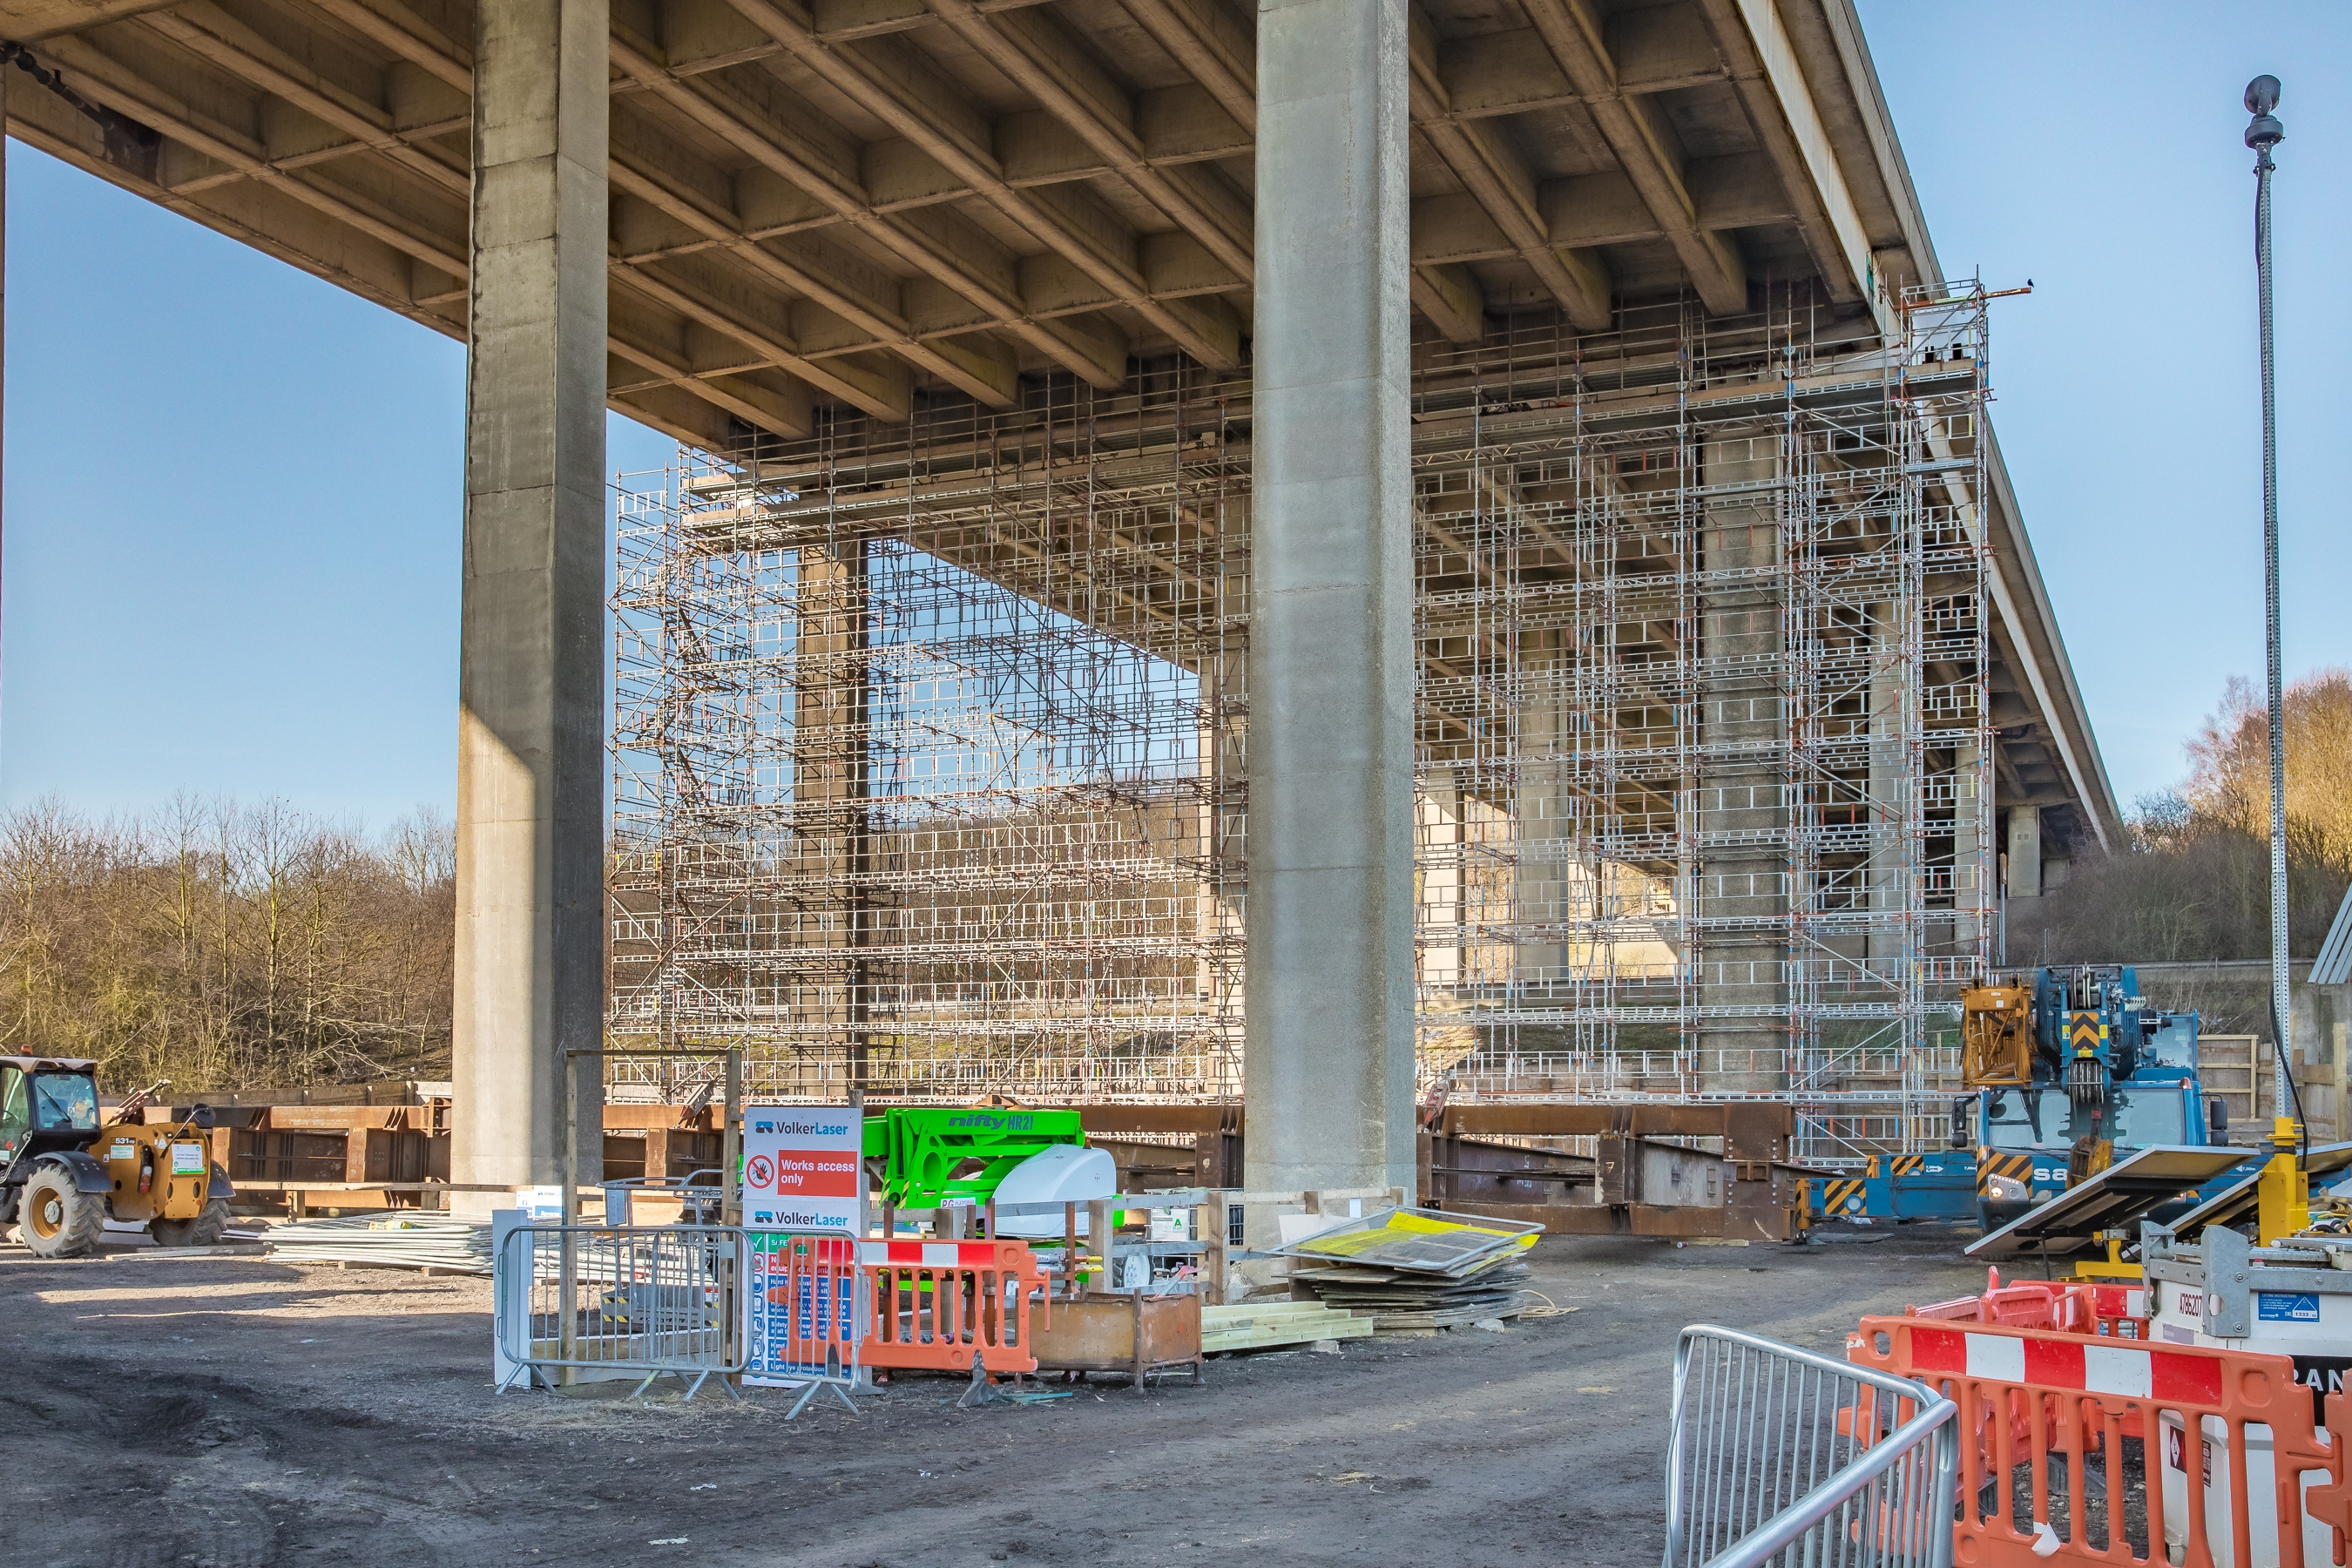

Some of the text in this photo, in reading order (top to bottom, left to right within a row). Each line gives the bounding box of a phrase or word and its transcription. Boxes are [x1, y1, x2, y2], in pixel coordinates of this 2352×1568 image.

[776, 1121, 848, 1135] VolkerLaser
[948, 1114, 1034, 1130] nifty HR21
[781, 1159, 855, 1173] Works access
[781, 1173, 804, 1186] only
[2033, 1167, 2068, 1181] sa
[775, 1211, 848, 1226] VolkerLaser
